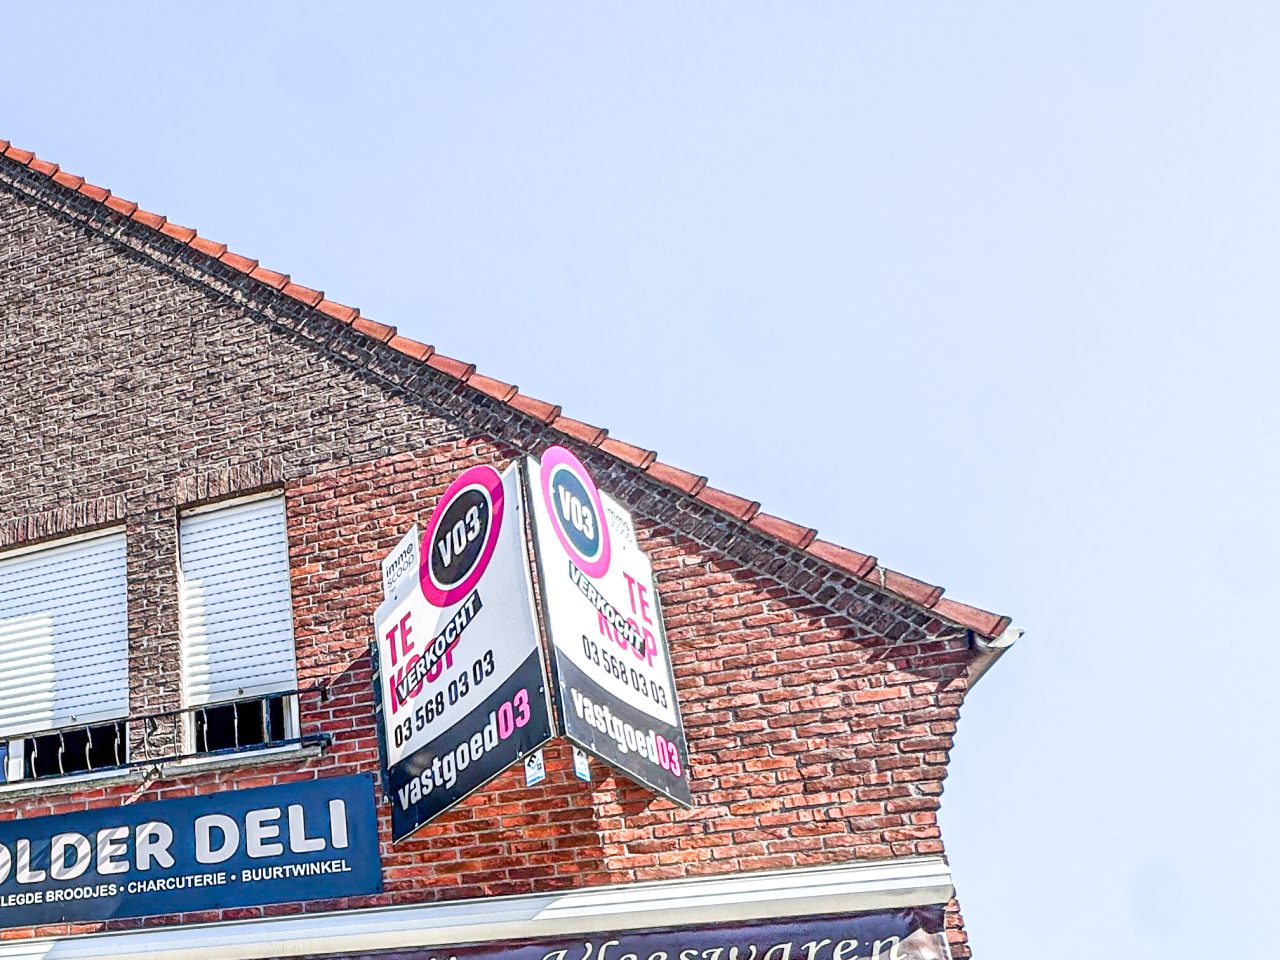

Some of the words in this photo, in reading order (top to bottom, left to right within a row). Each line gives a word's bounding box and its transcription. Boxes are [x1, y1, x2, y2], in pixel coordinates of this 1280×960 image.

[385, 611, 415, 667] TE
[570, 562, 645, 652] VERKOCHT
[622, 571, 653, 626] TE
[397, 595, 477, 700] VERKOCHT
[582, 634, 600, 667] 03
[601, 648, 629, 686] 568
[630, 668, 649, 698] 03
[650, 680, 668, 709] 03
[394, 716, 413, 749] 03
[415, 690, 445, 732] 568
[447, 670, 470, 706] 03
[472, 649, 495, 687] 03
[571, 688, 681, 777] vastgoed03
[397, 688, 531, 811] vastgoed03
[194, 799, 348, 867] DELI
[46, 884, 118, 903] BROODJES
[127, 872, 227, 895] CHARCUTERIE
[241, 860, 352, 883] BUURTWINKEL
